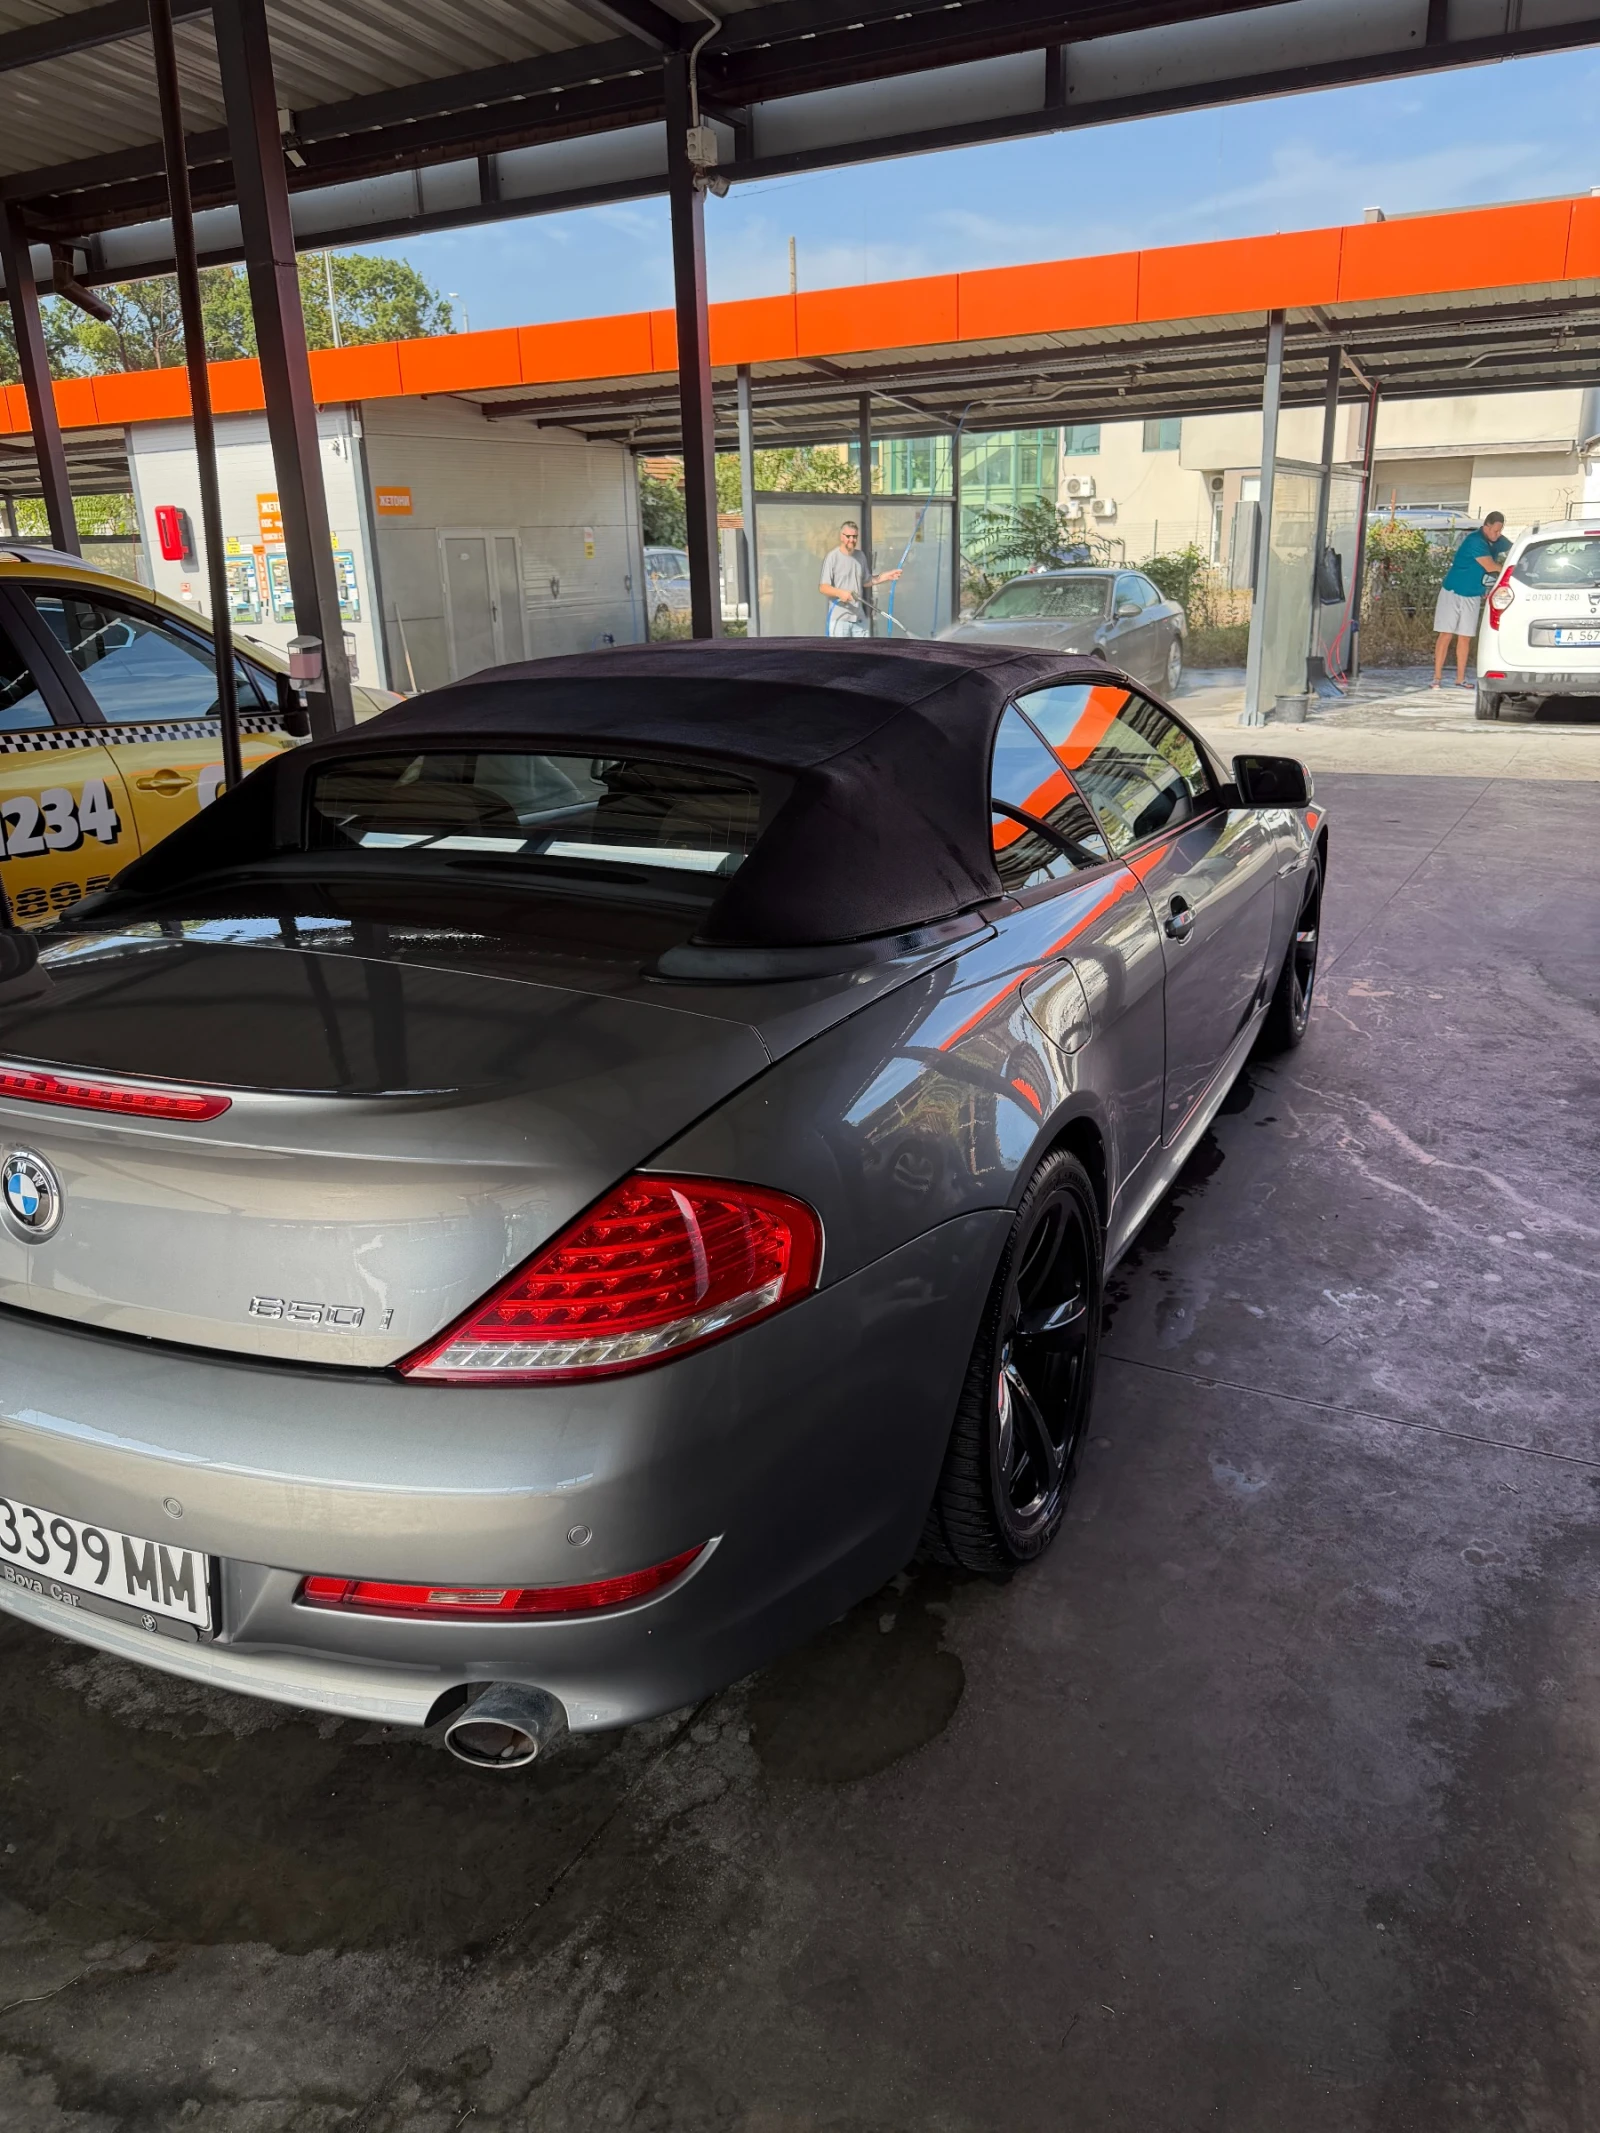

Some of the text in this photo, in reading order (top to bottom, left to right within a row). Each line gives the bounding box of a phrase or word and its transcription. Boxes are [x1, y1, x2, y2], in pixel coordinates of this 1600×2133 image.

[1566, 631, 1574, 641] A
[5, 1161, 45, 1187] BMW
[249, 1296, 365, 1329] 650
[0, 1497, 197, 1614] 3399 MM
[3, 1565, 80, 1608] Bova Car
